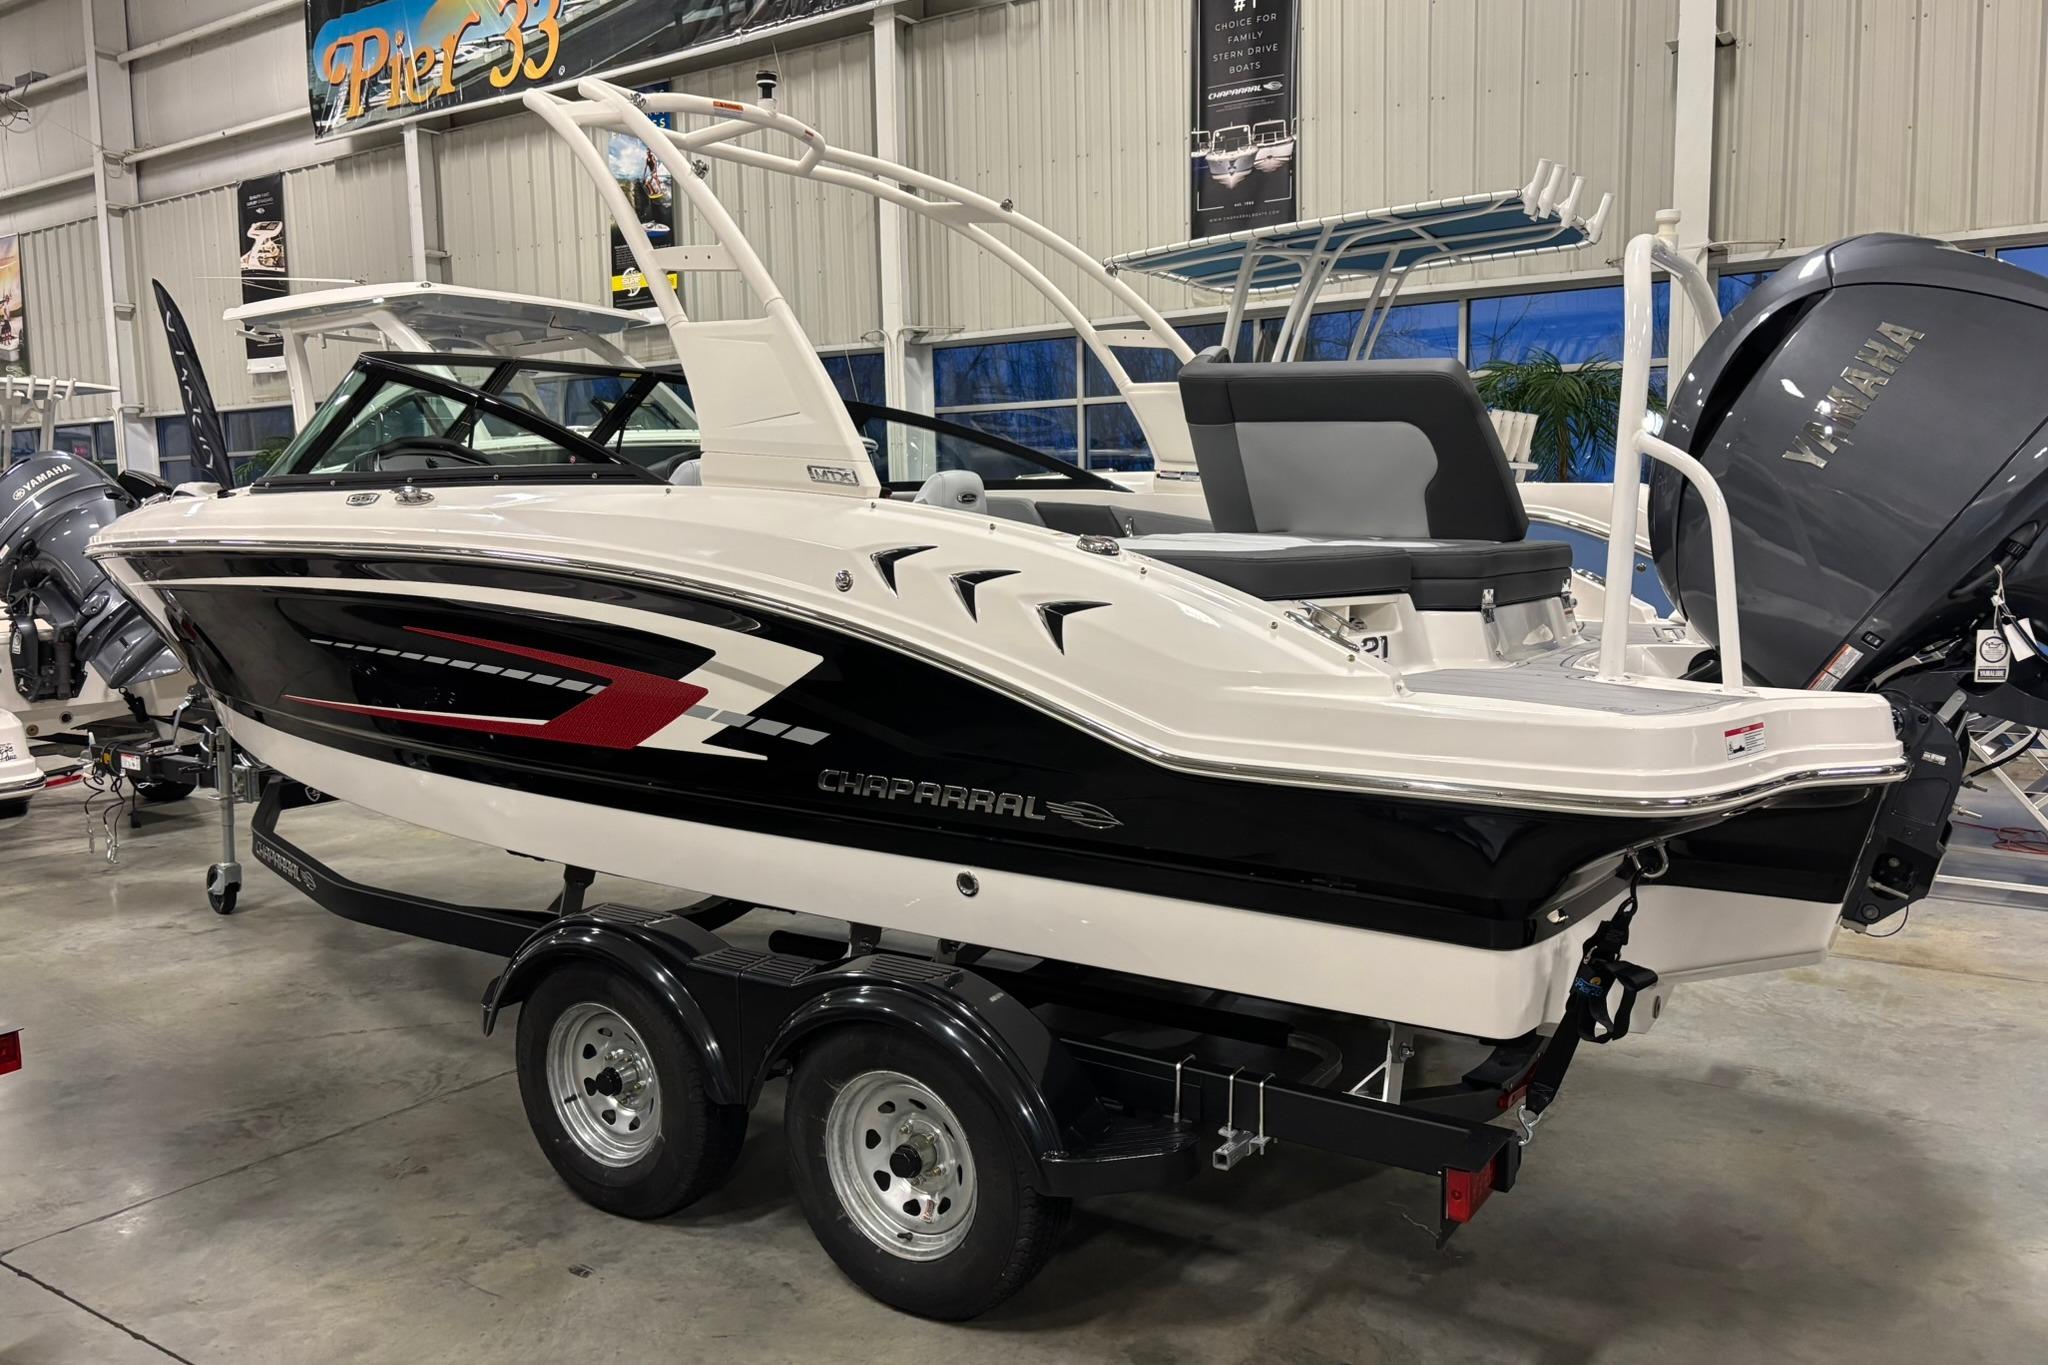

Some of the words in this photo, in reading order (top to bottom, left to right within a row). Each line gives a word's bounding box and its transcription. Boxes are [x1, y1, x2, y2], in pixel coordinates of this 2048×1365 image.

[1214, 17, 1252, 32] CHOICE
[1256, 13, 1277, 23] FOR
[1227, 30, 1263, 44] FAMILY
[322, 13, 481, 120] Pier
[489, 0, 561, 88] 33
[1212, 50, 1243, 62] STERN
[1247, 43, 1278, 56] DRIVE
[1229, 61, 1261, 74] BOATS
[1208, 84, 1262, 100] CHAPARRAL
[1782, 321, 1925, 469] YAMAHA
[22, 463, 72, 491] YAMAHA
[814, 468, 854, 483] MTX
[817, 768, 1046, 821] CHAPARRAL
